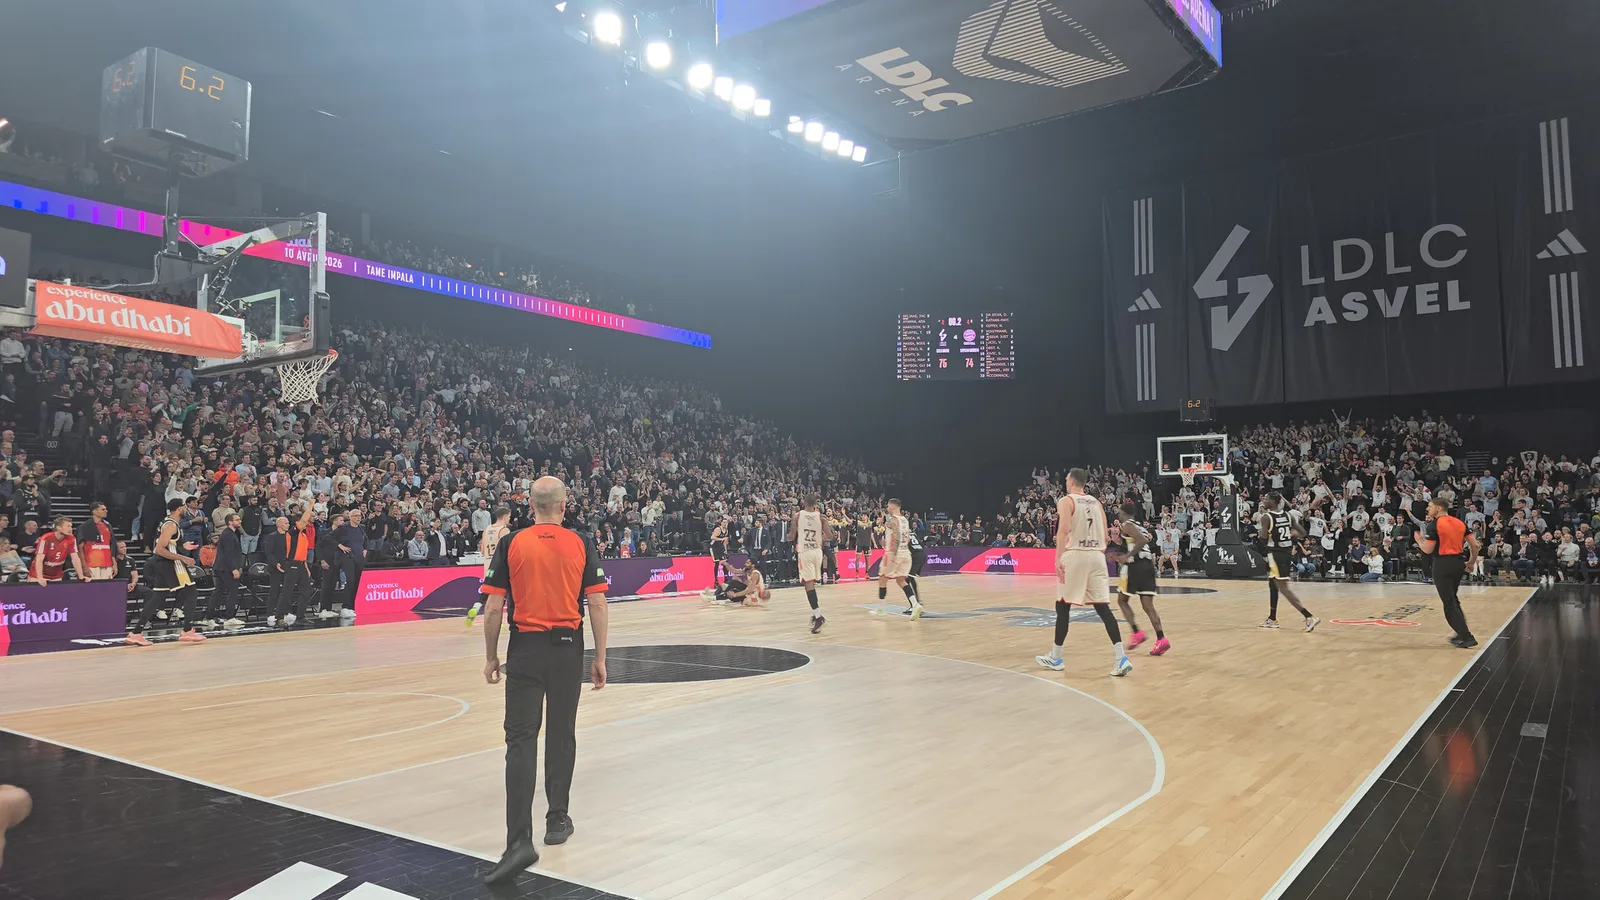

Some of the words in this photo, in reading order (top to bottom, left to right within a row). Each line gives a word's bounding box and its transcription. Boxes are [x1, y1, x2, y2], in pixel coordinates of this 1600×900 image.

[180, 66, 224, 100] 6.2
[855, 46, 974, 112] LDLC
[835, 63, 924, 116] ARENA
[285, 248, 294, 258] 10
[1300, 224, 1468, 286] LDLC
[366, 264, 386, 278] TAME
[388, 269, 414, 284] IMPALA
[47, 285, 127, 304] experience
[1304, 280, 1470, 327] ASVEL
[46, 299, 106, 325] abu
[110, 308, 192, 336] dhabi
[966, 358, 974, 368] 74
[1087, 518, 1093, 528] 7
[804, 529, 816, 541] 22
[1278, 526, 1291, 541] 24
[650, 573, 664, 582] abu
[664, 572, 684, 581] dhabi
[366, 590, 388, 601] abu
[390, 587, 424, 600] dhabi
[12, 608, 68, 625] dhabi
